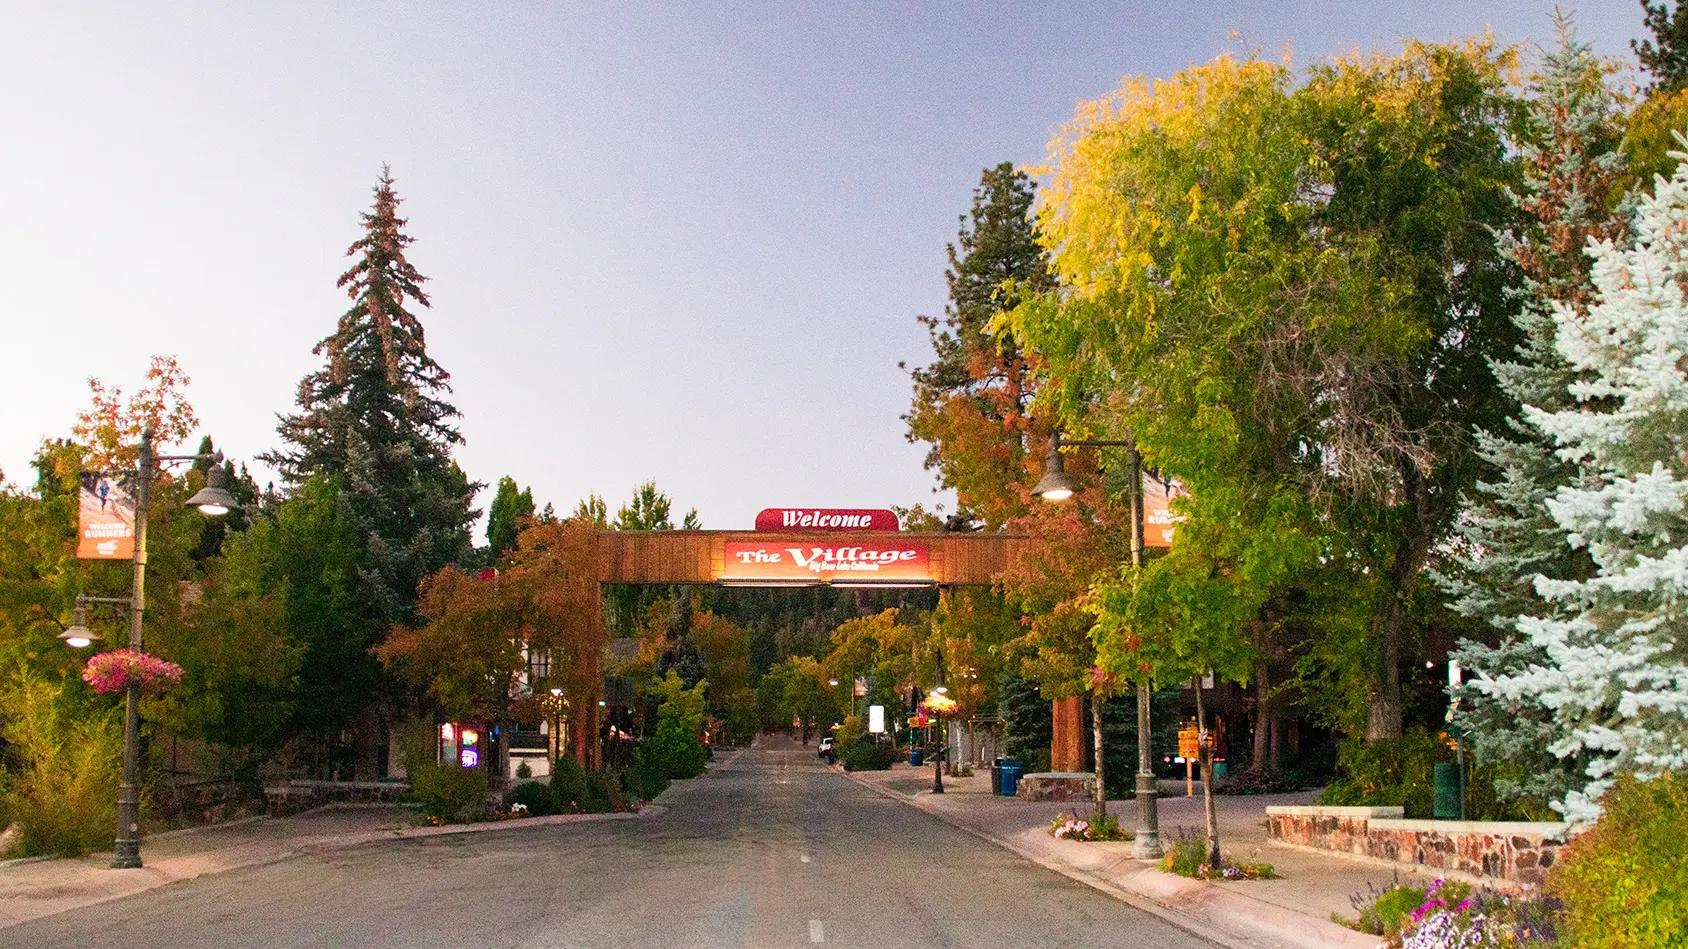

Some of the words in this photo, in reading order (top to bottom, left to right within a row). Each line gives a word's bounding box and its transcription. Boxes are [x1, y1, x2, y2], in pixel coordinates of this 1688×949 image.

[782, 511, 872, 528] Welcome
[85, 529, 131, 538] RUNNERS
[736, 549, 781, 563] The
[784, 547, 917, 567] Village
